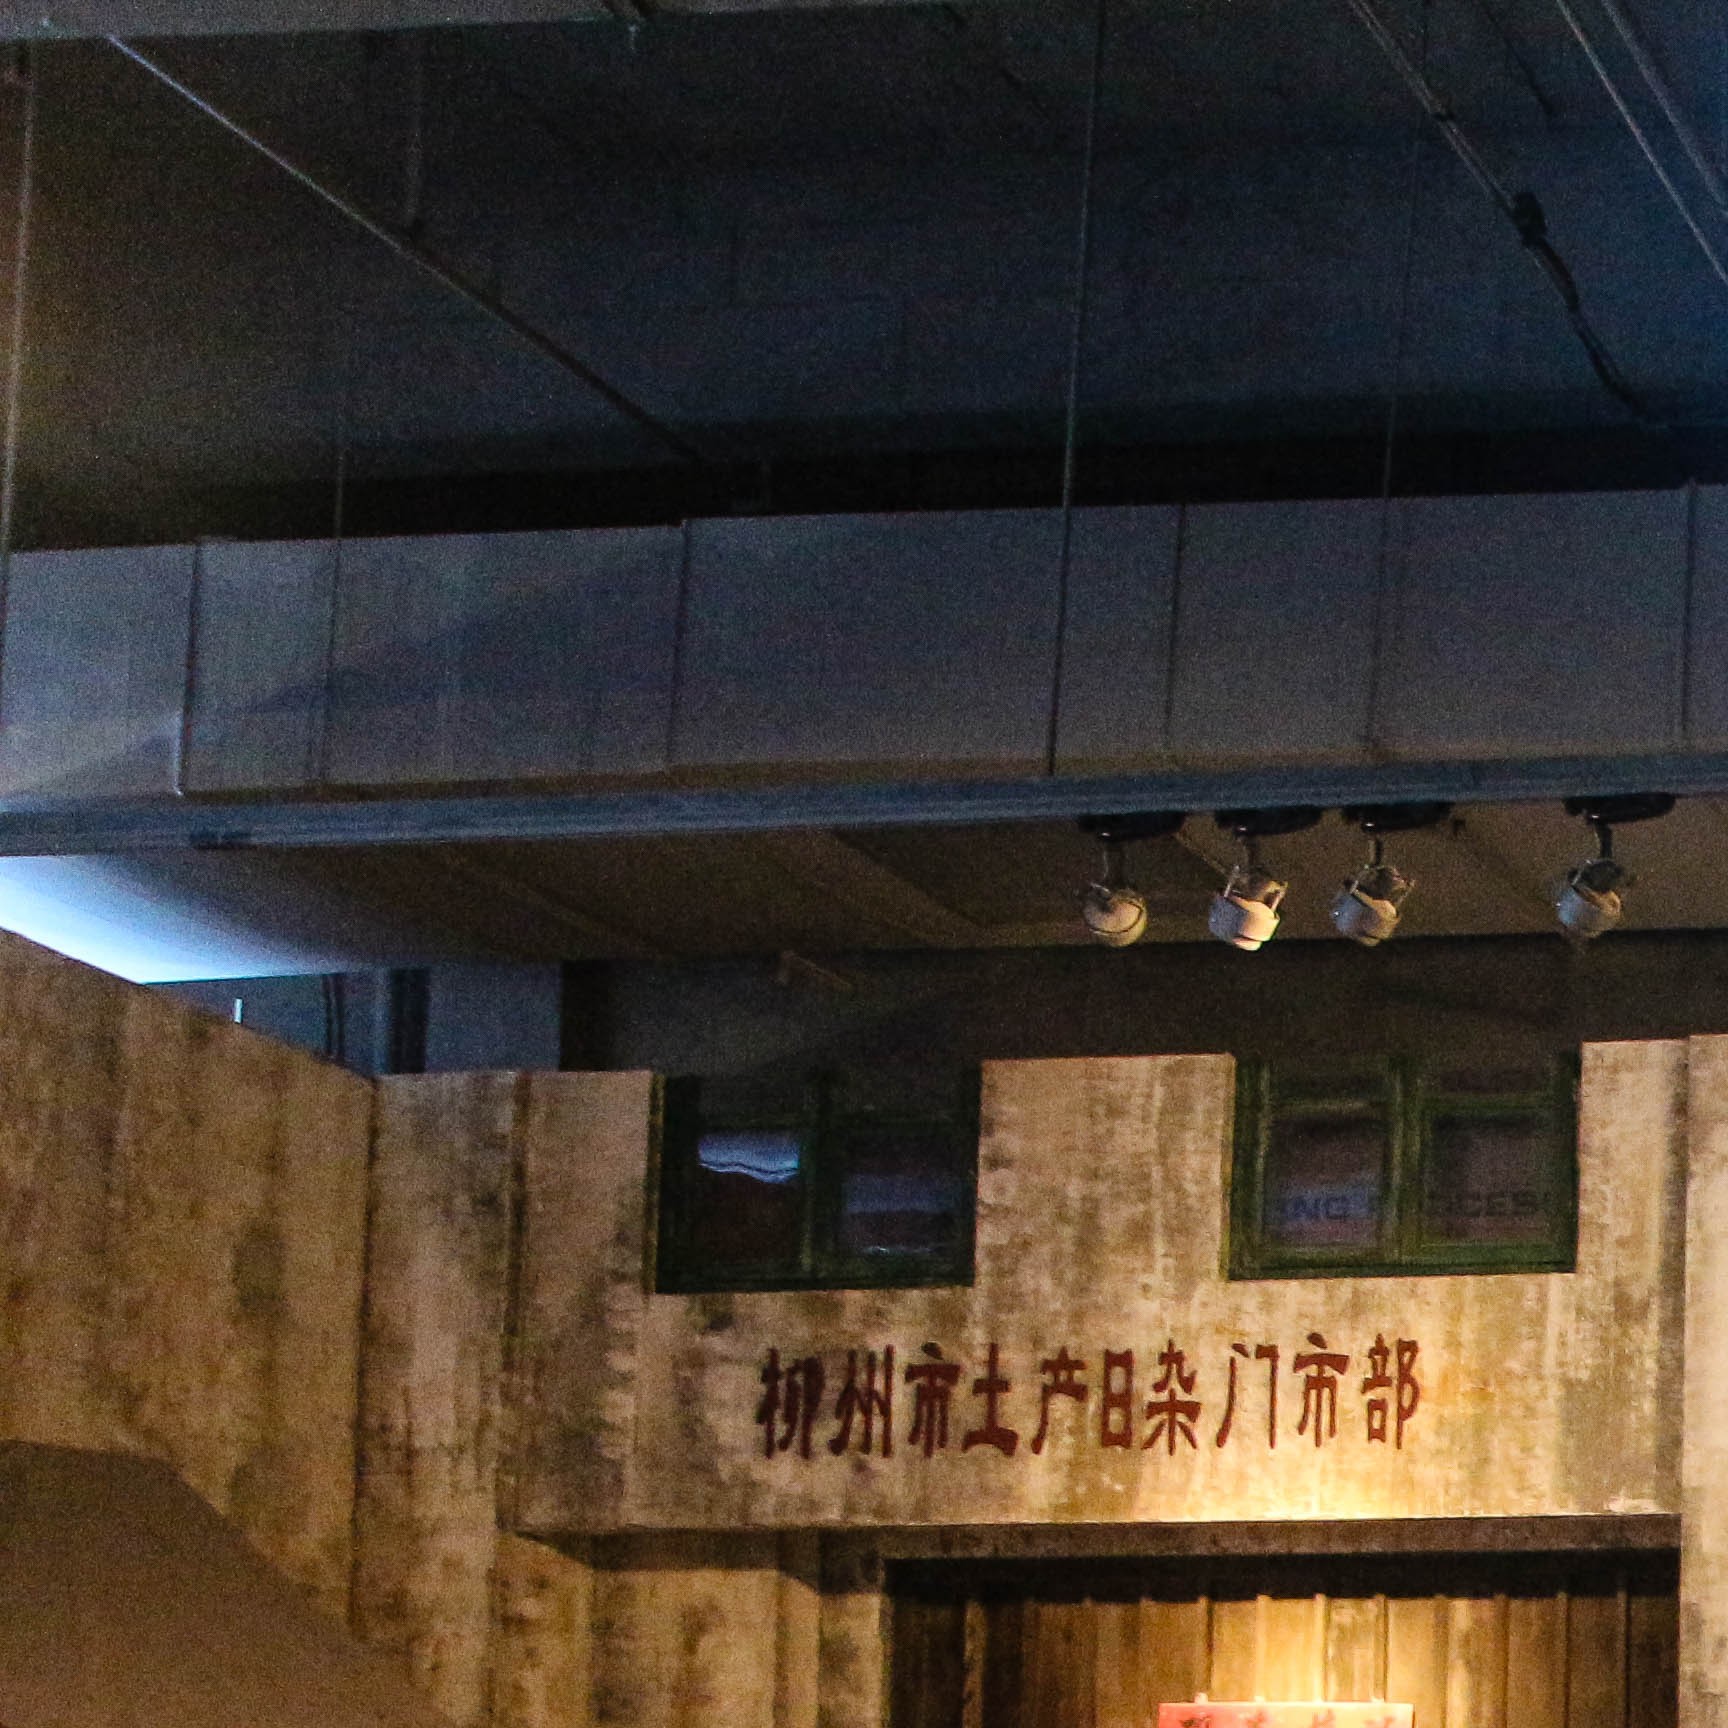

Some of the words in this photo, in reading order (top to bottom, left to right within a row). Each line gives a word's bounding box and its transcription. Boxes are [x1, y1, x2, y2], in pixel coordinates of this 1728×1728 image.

[756, 1332, 1421, 1459] 柳州市土产日杂门市部
